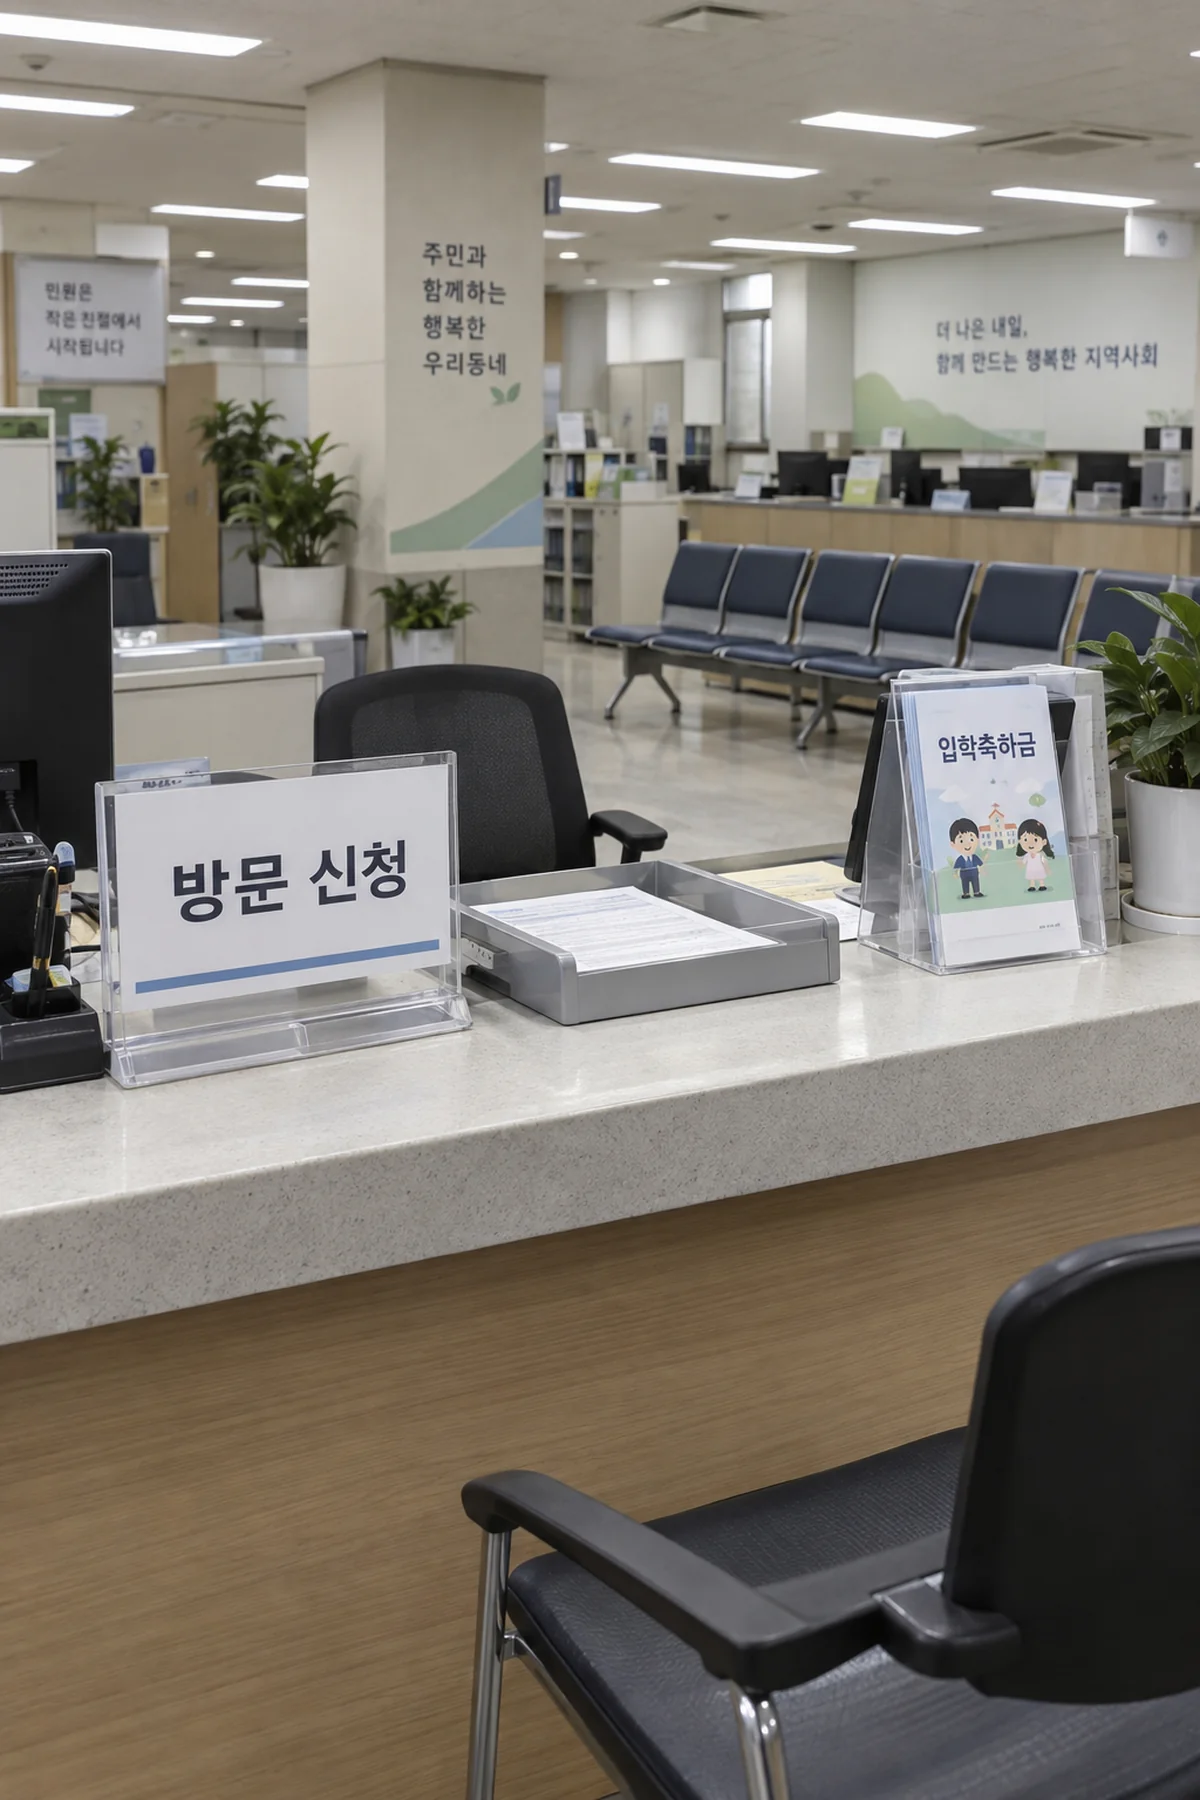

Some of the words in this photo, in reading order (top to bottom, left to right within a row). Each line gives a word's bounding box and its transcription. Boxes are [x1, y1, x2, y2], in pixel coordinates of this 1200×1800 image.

[422, 242, 486, 269] 주민과
[45, 282, 92, 302] 민원은
[422, 277, 506, 305] 함께하는
[46, 309, 75, 329] 작은
[81, 311, 141, 330] 친절에서
[423, 314, 486, 341] 행복한
[937, 320, 950, 342] 더
[956, 317, 984, 341] 나은
[992, 313, 1028, 339] 내일,
[46, 337, 124, 357] 시작됩니다
[937, 352, 965, 375] 함께
[972, 350, 1019, 374] 만드는
[1026, 346, 1076, 373] 행복한
[1085, 341, 1158, 370] 지역사회
[422, 351, 507, 376] 우리동네
[938, 731, 1036, 763] 입학축하금
[173, 854, 288, 923] 방문
[309, 839, 406, 905] 신청
